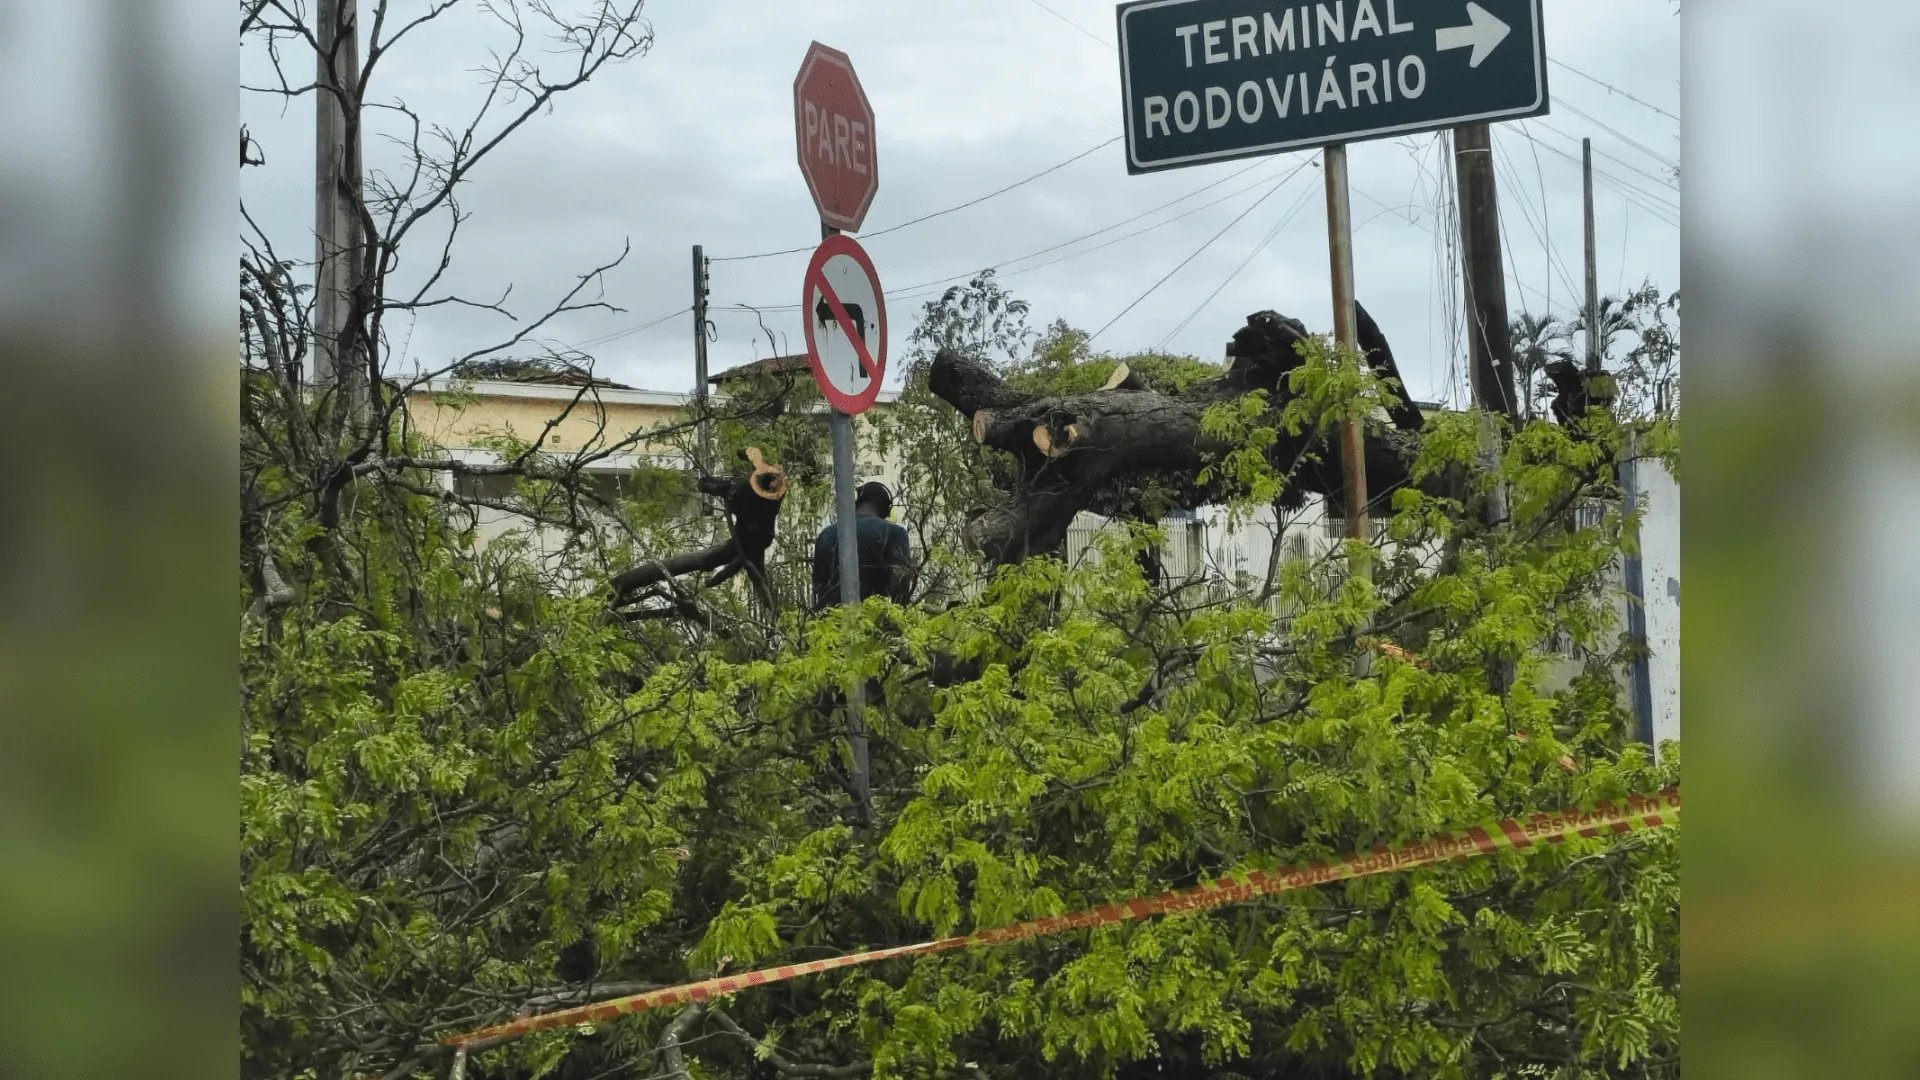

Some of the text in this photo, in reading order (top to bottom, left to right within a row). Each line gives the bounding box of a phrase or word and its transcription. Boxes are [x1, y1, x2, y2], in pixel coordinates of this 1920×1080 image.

[1175, 0, 1414, 68] TERMINAL
[1143, 54, 1426, 139] RODOVIÁRIO
[804, 100, 867, 175] PARE
